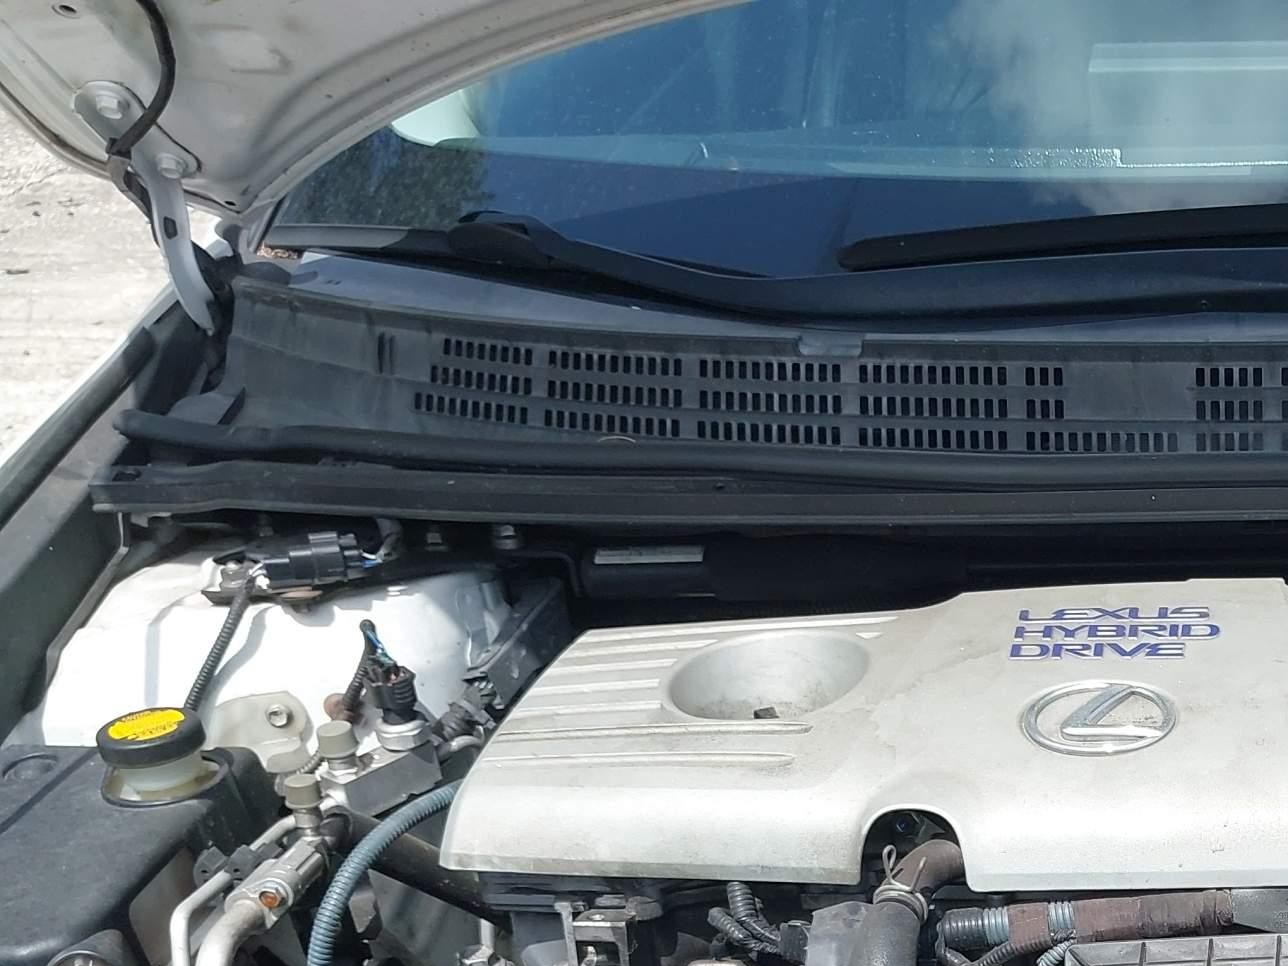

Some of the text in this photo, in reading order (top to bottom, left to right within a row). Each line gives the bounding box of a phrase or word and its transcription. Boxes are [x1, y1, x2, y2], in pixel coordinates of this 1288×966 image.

[1018, 606, 1211, 622] LEXUS
[1013, 623, 1222, 641] HYBRID
[1008, 642, 1187, 660] DRIVE
